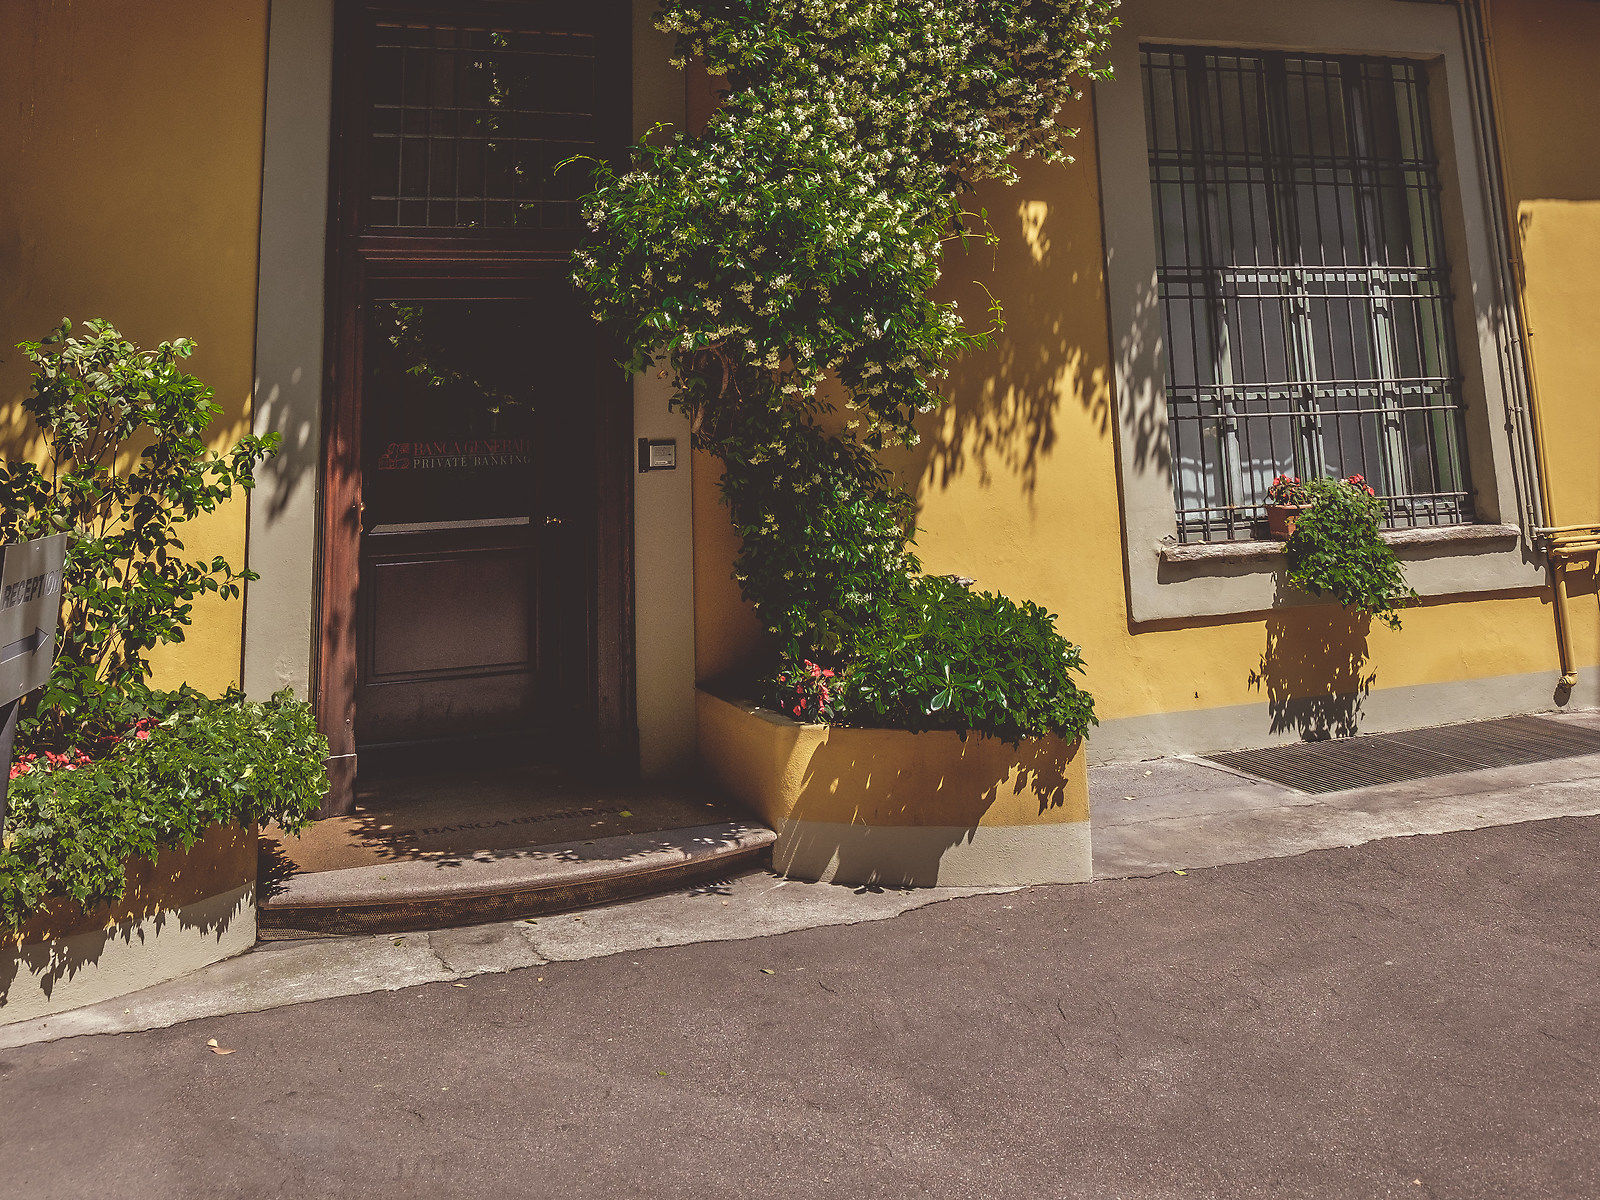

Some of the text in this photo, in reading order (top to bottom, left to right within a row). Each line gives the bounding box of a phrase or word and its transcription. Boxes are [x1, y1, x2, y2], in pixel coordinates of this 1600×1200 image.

[414, 440, 462, 456] BANCA
[413, 455, 532, 469] PRIVATE BANKING
[2, 568, 61, 610] RECEPTION
[421, 819, 509, 836] BANCA
